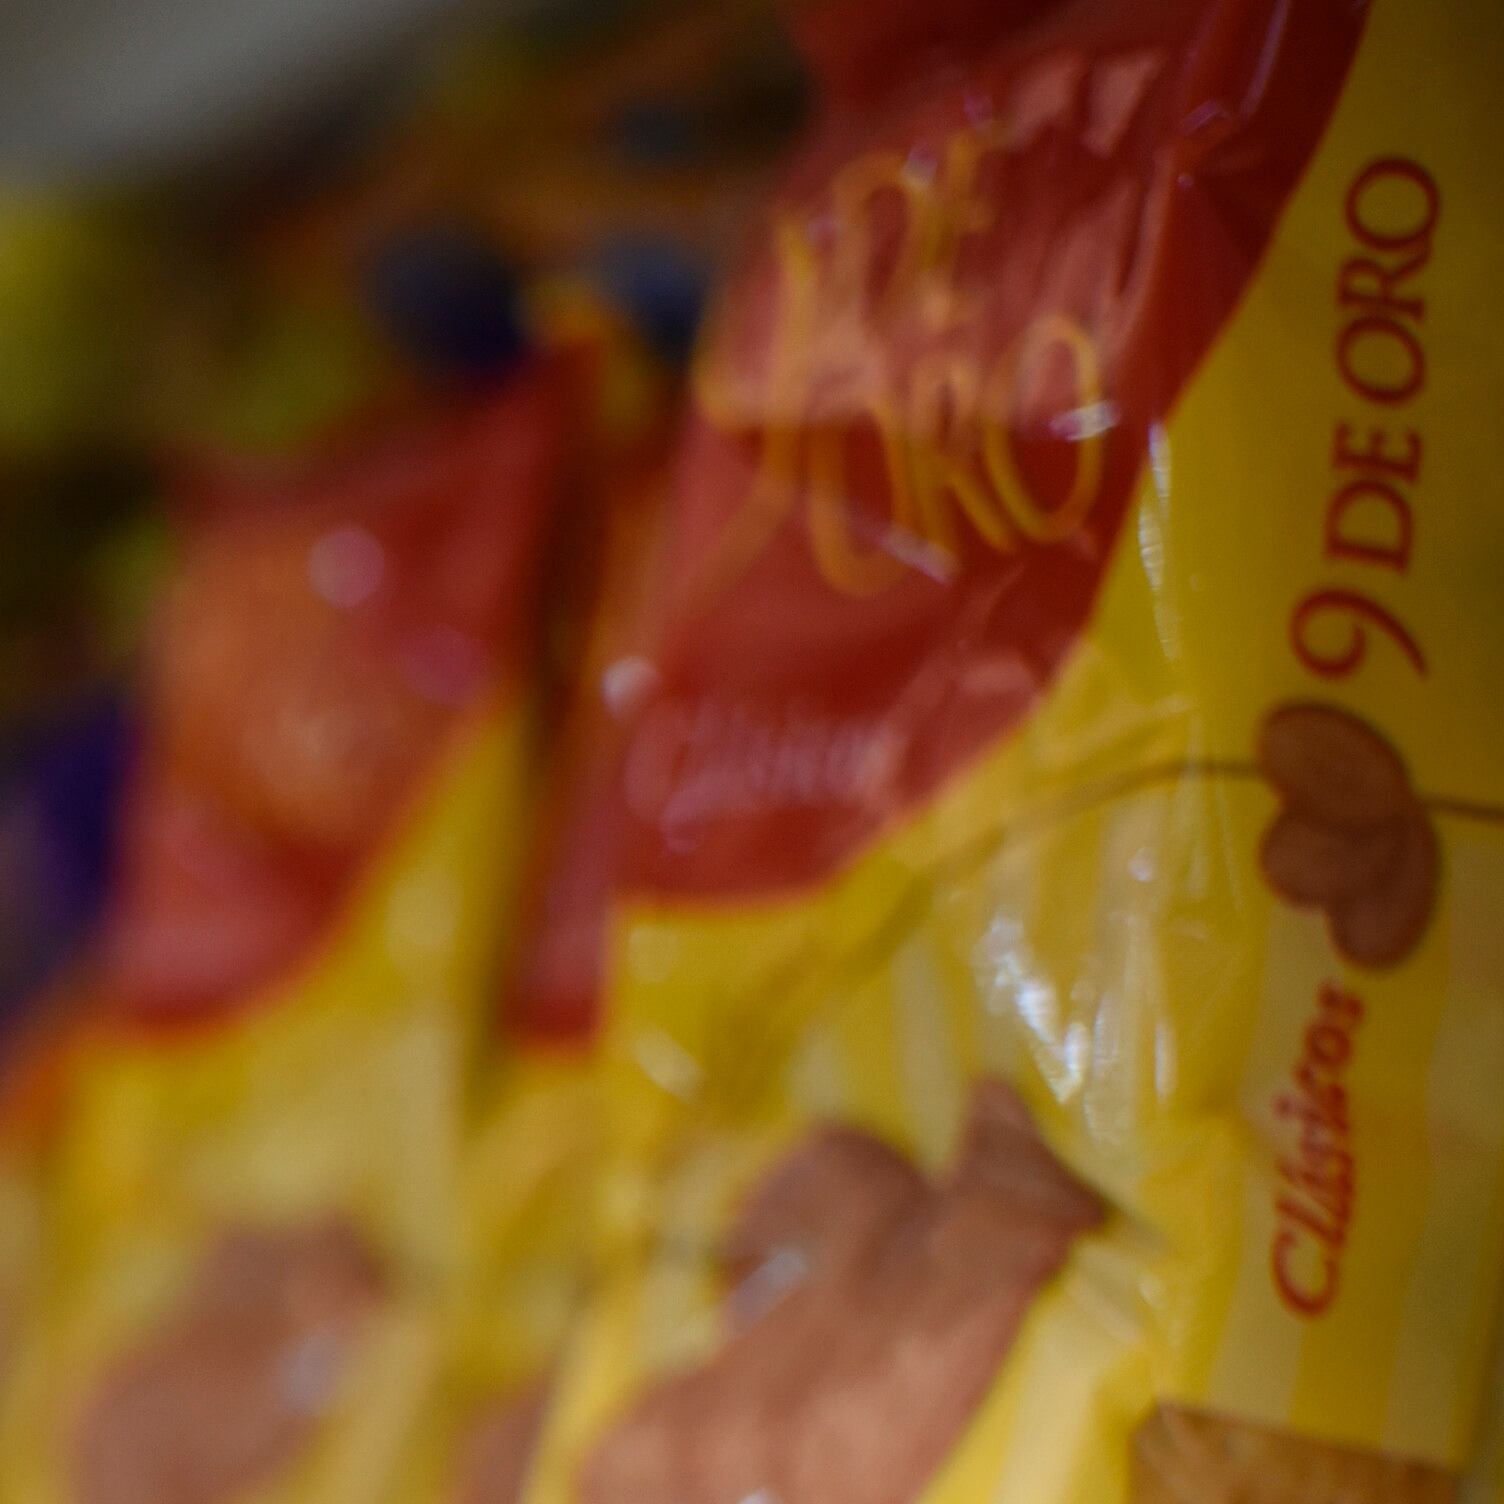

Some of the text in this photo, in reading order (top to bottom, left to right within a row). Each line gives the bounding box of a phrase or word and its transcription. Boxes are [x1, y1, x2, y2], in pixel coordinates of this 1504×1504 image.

[1288, 156, 1441, 681] 9 DE ORO
